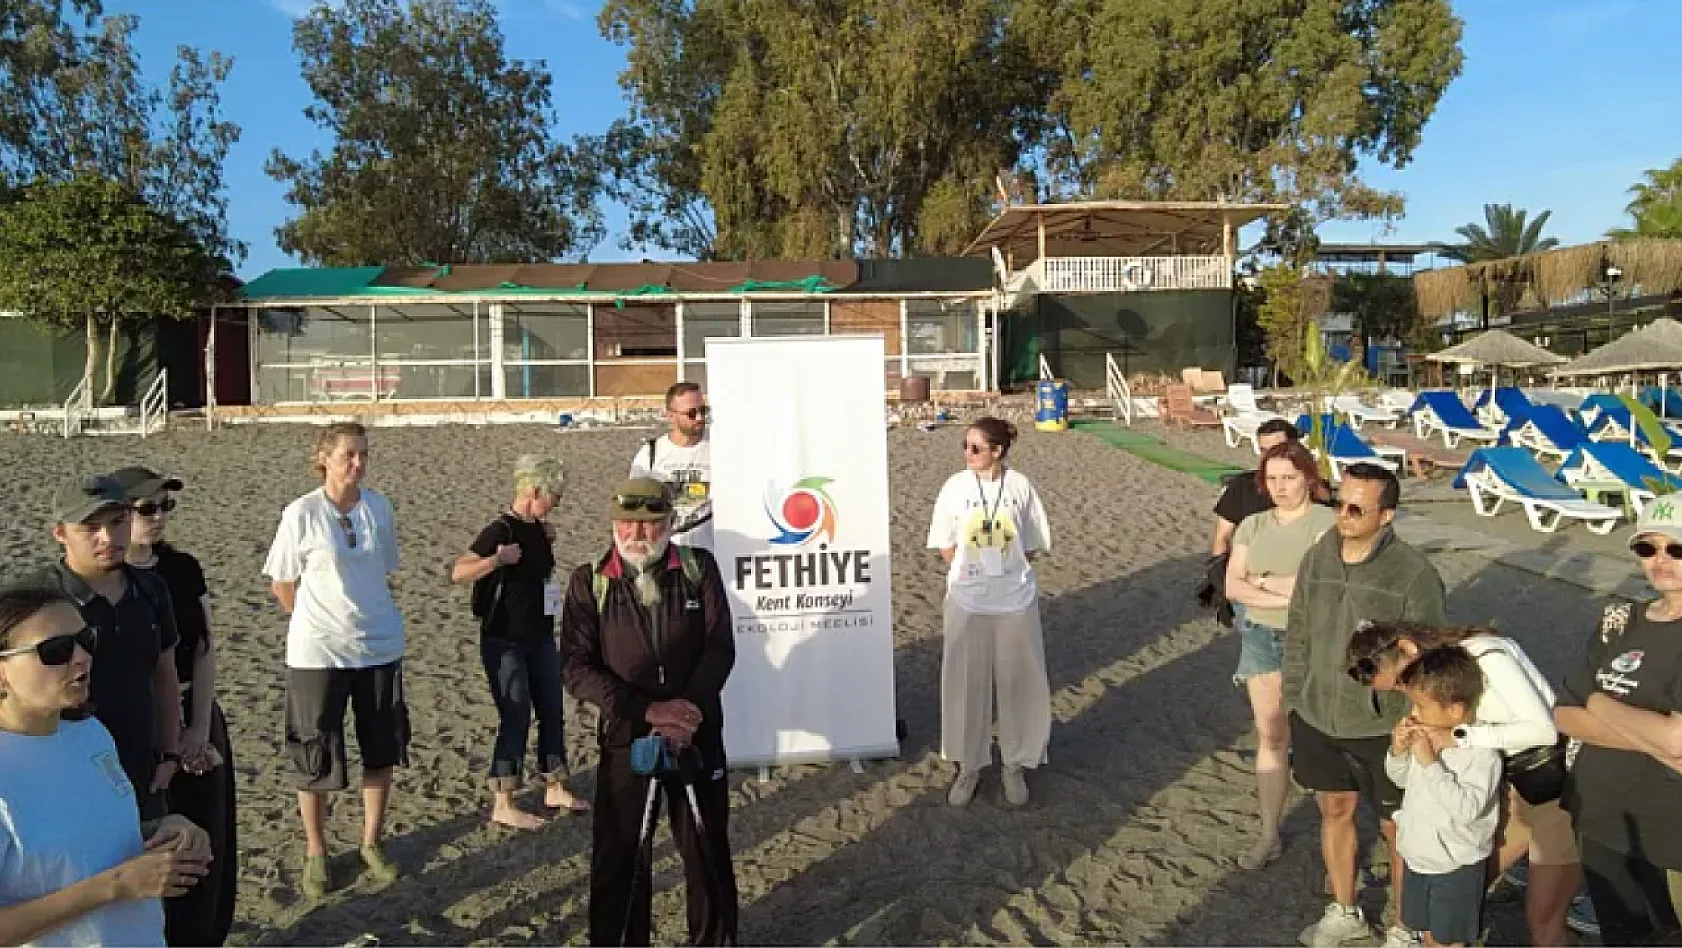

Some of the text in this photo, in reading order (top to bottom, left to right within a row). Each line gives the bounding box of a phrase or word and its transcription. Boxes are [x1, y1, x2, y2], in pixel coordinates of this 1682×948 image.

[735, 543, 872, 590] FETHİYE
[756, 589, 853, 611] Kent Konseyi
